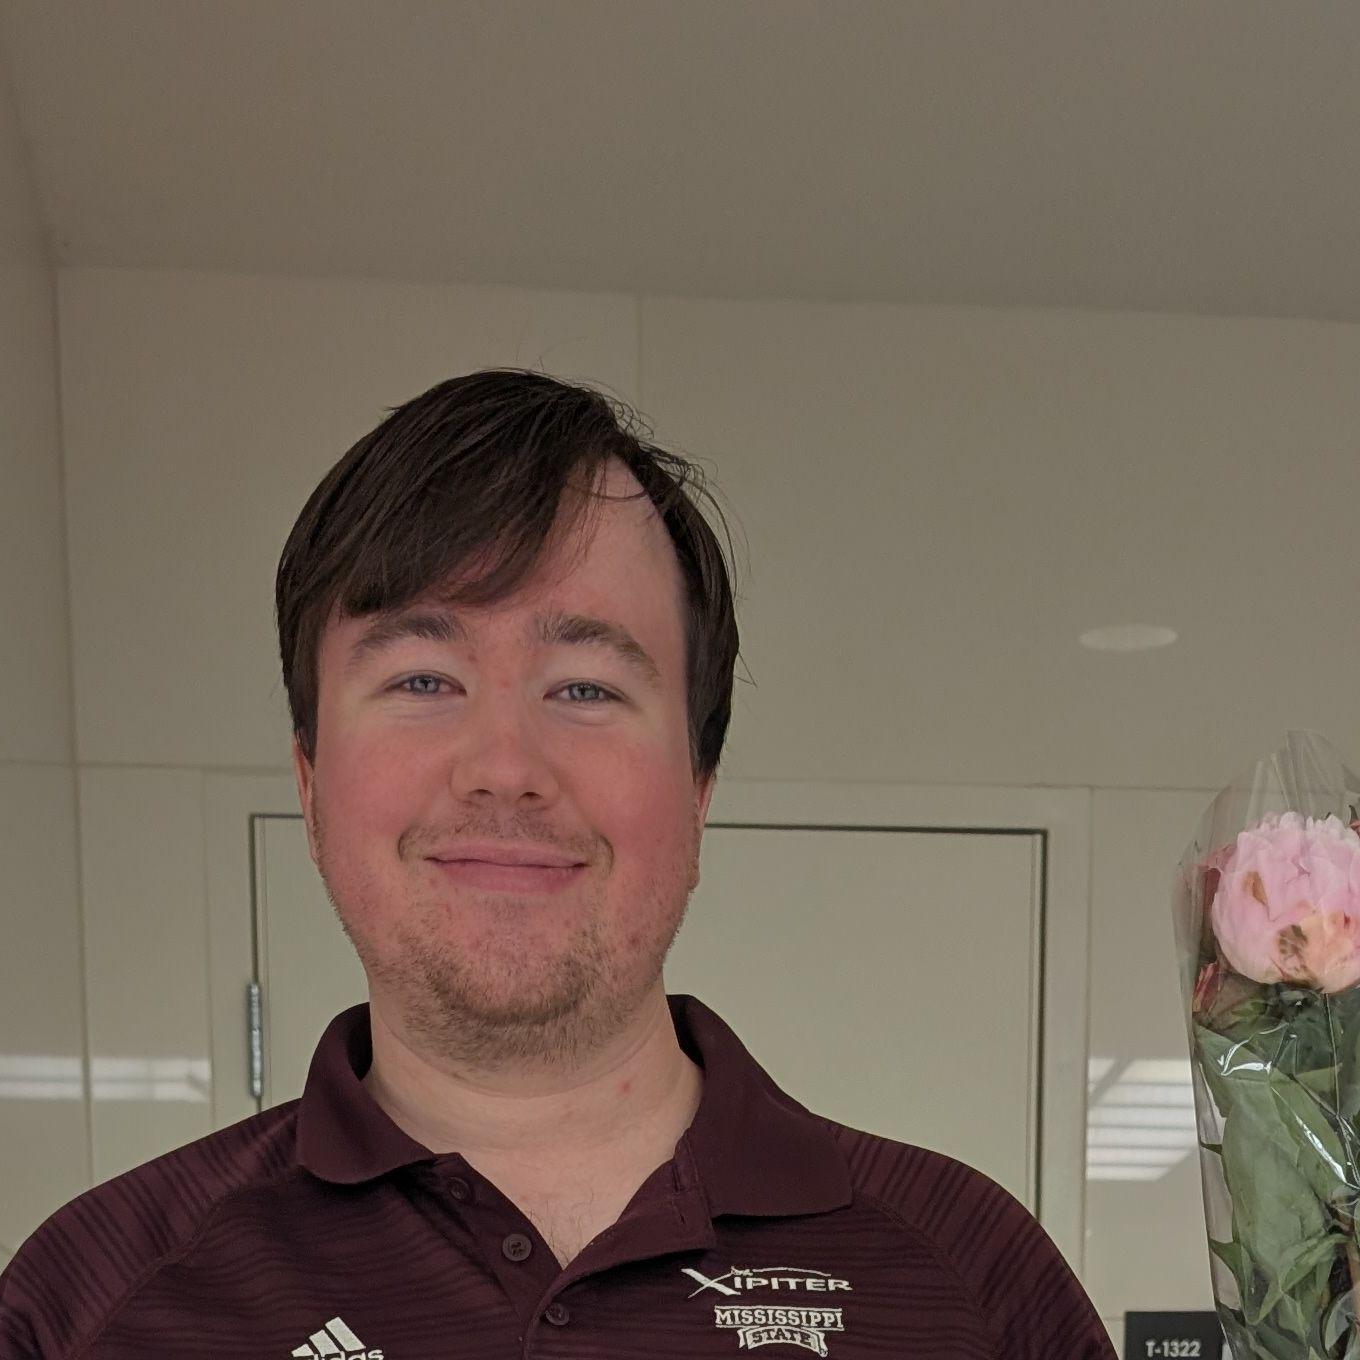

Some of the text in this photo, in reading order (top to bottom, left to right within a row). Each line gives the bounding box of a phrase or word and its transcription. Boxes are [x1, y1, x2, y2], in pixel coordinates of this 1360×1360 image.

[715, 1308, 844, 1328] MISSISSIPPI
[752, 1328, 814, 1346] STATE
[1145, 1340, 1201, 1357] T-1322
